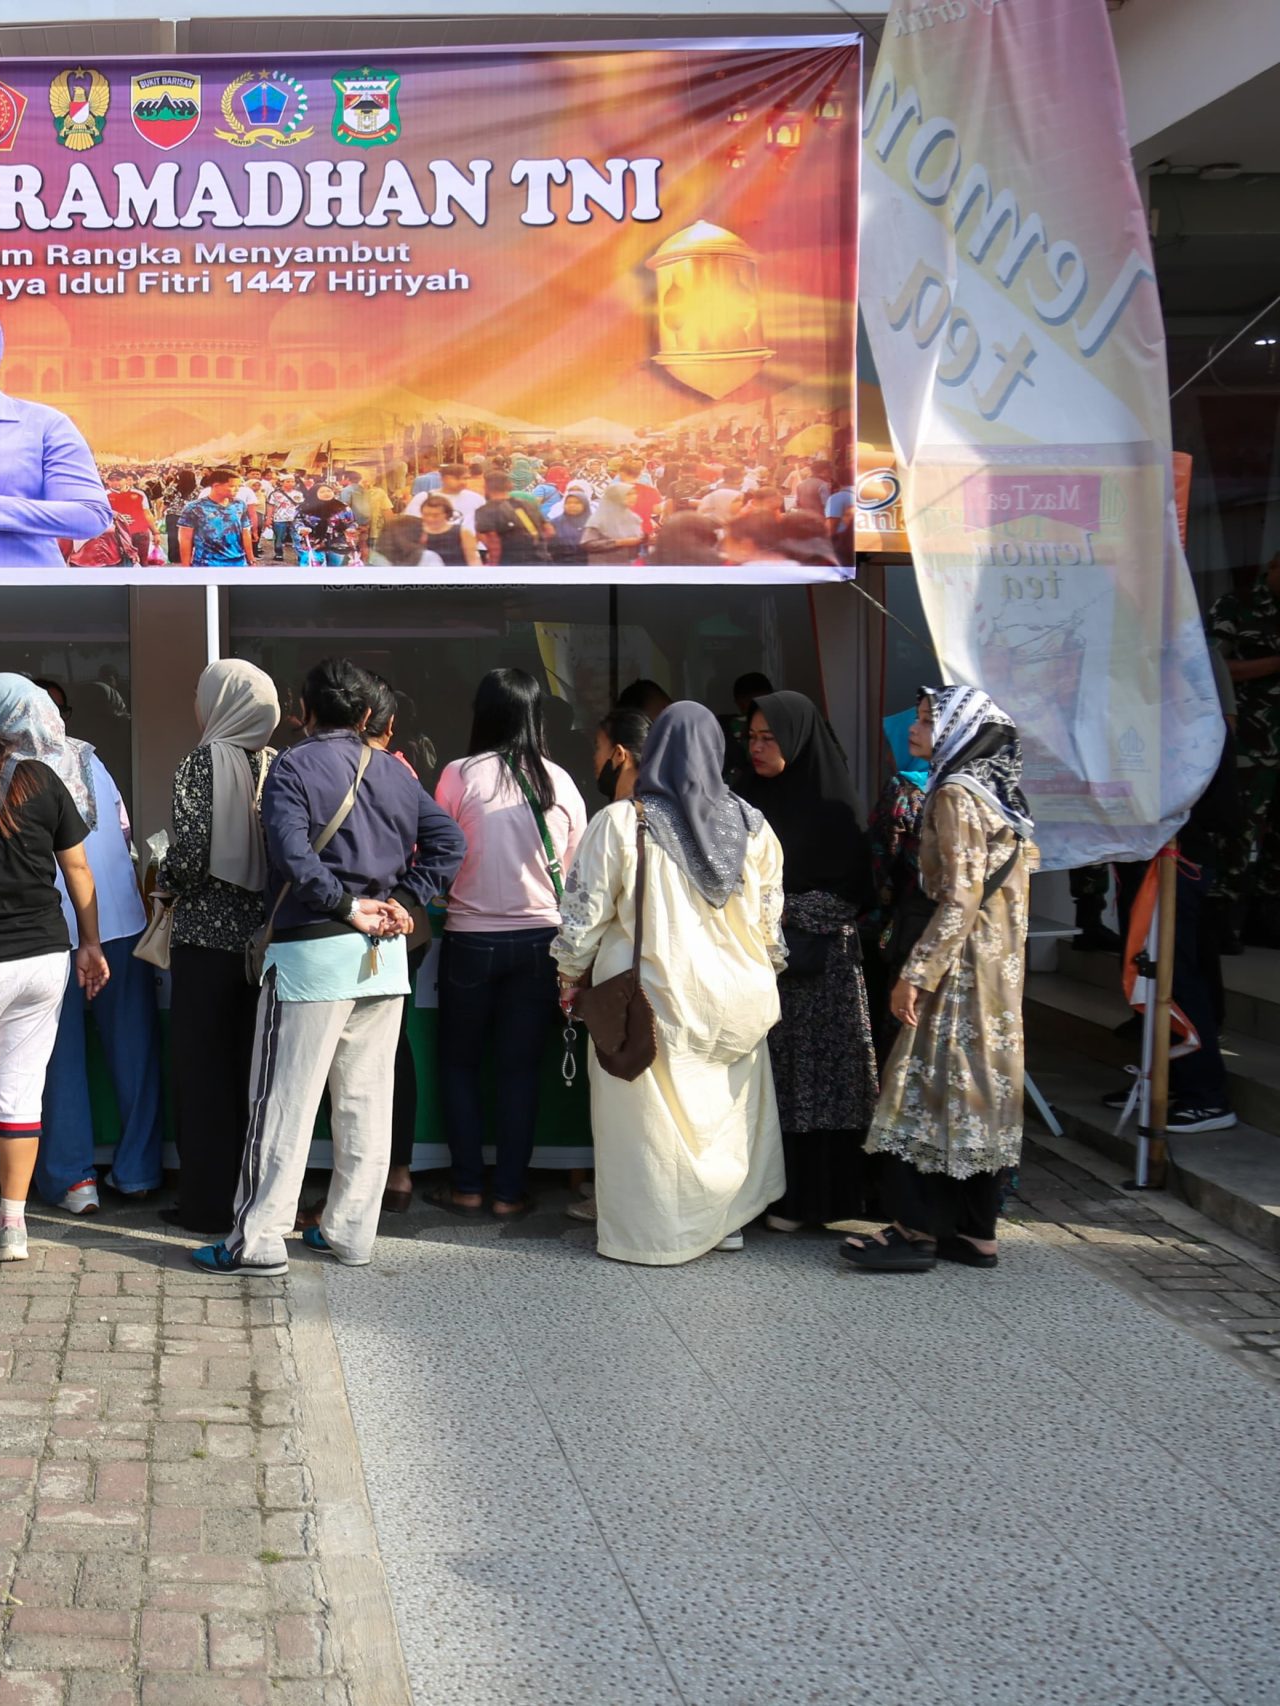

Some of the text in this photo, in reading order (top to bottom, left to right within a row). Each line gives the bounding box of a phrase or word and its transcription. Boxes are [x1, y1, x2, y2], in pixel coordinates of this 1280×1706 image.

[139, 77, 194, 89] BUKIT BARISAN
[275, 137, 297, 145] TIMUR
[511, 158, 661, 226] TNI
[47, 243, 181, 270] Rangka
[195, 242, 410, 268] Menyambut
[60, 271, 124, 295] Idul
[139, 270, 210, 294] Fitri
[225, 270, 316, 293] 1447
[329, 268, 470, 297] Hijriyah
